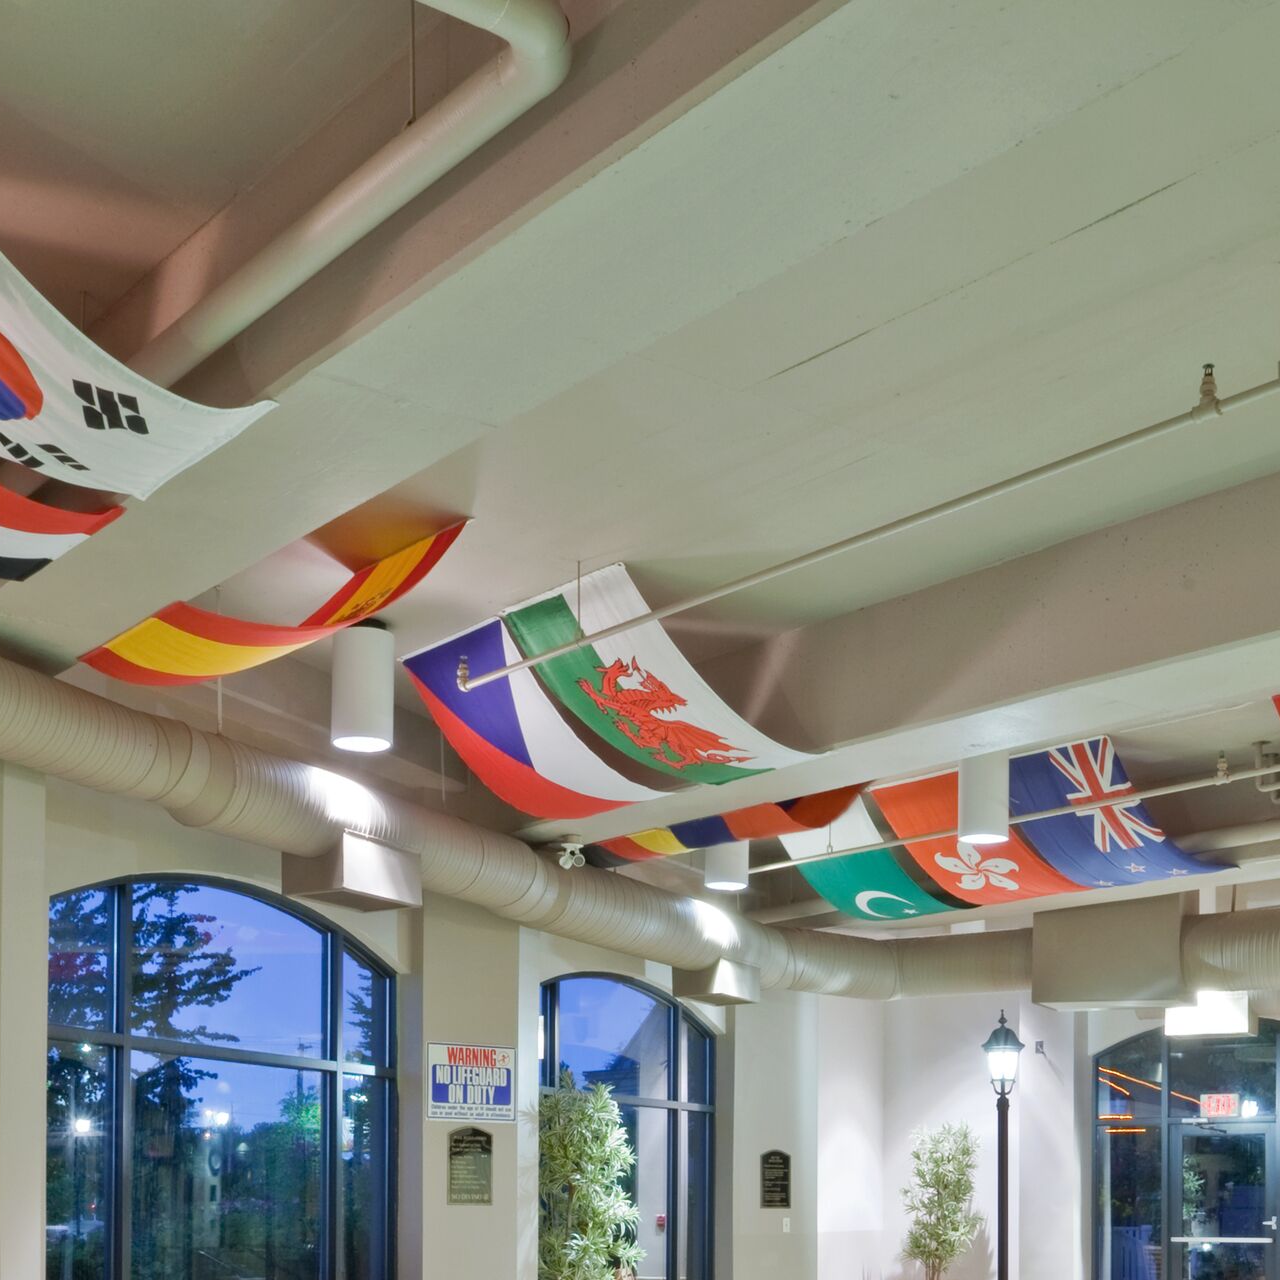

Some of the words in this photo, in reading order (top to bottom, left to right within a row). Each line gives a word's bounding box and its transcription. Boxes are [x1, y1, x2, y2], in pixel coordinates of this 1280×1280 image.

[447, 1046, 497, 1067] WARNING
[435, 1064, 451, 1085] NO
[452, 1065, 507, 1087] LIFEGUARD
[448, 1084, 464, 1104] ON
[467, 1084, 496, 1105] DUTY
